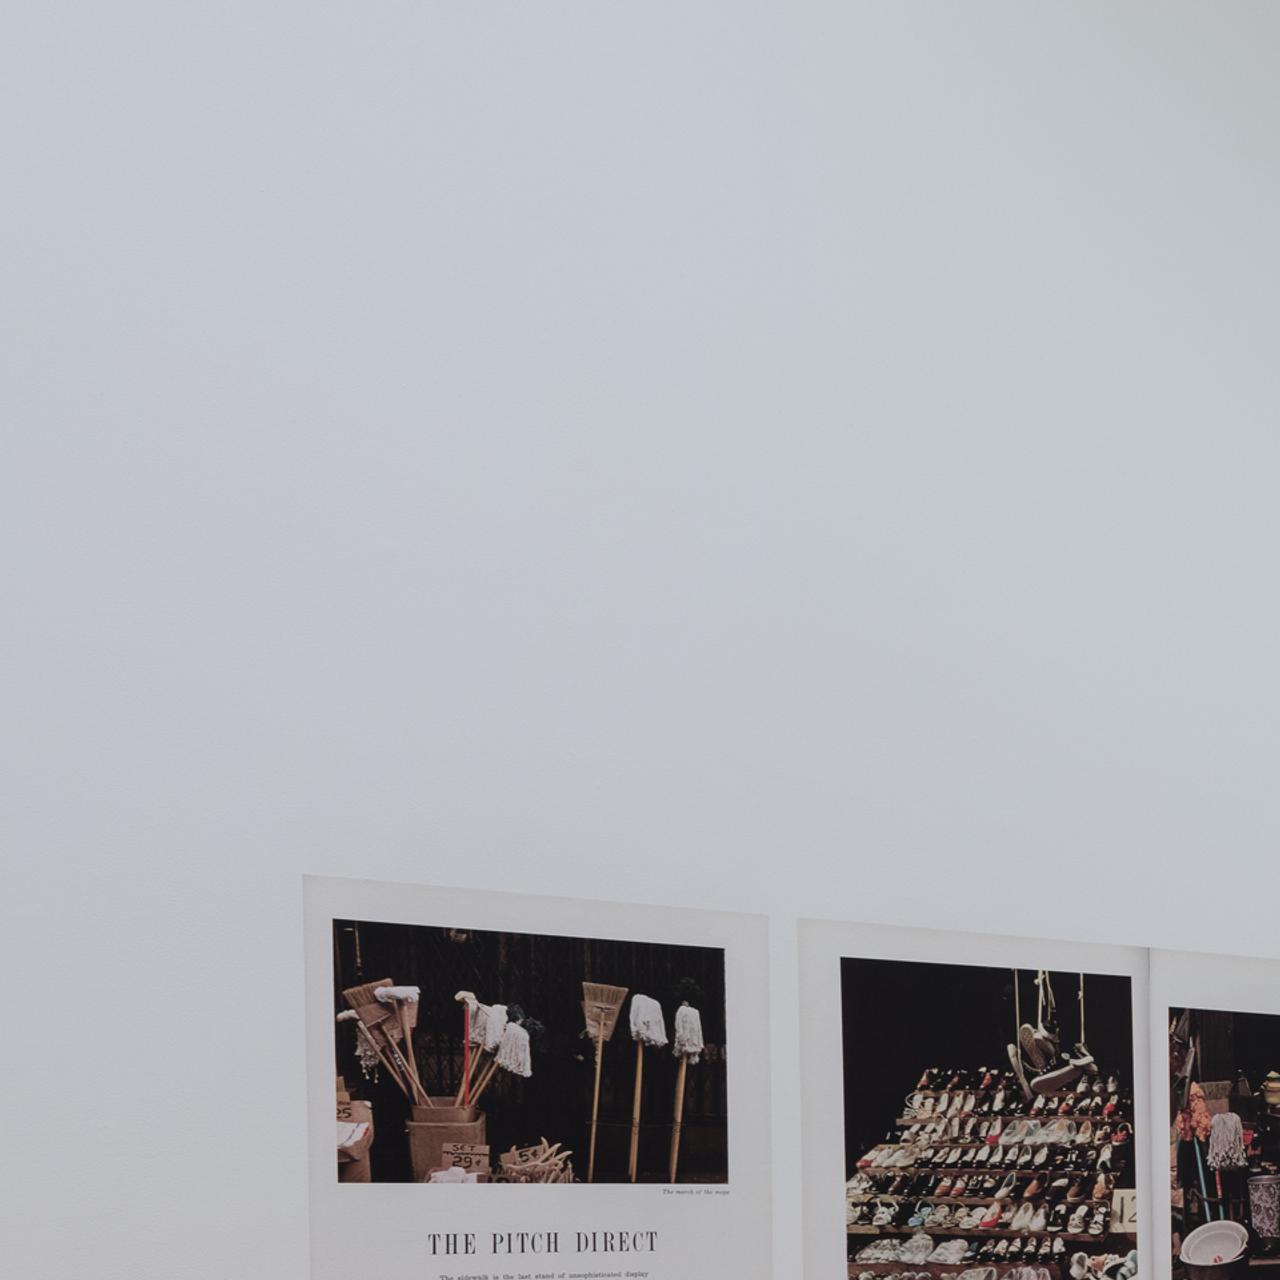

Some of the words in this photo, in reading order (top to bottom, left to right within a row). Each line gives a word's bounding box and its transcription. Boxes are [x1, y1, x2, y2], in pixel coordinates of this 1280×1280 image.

[428, 1232, 476, 1255] THE
[492, 1231, 560, 1254] PITCH
[576, 1230, 659, 1253] DIRECT
[457, 1273, 489, 1280] sidewalk
[568, 1271, 622, 1280] unsophisticated
[625, 1271, 648, 1279] display
